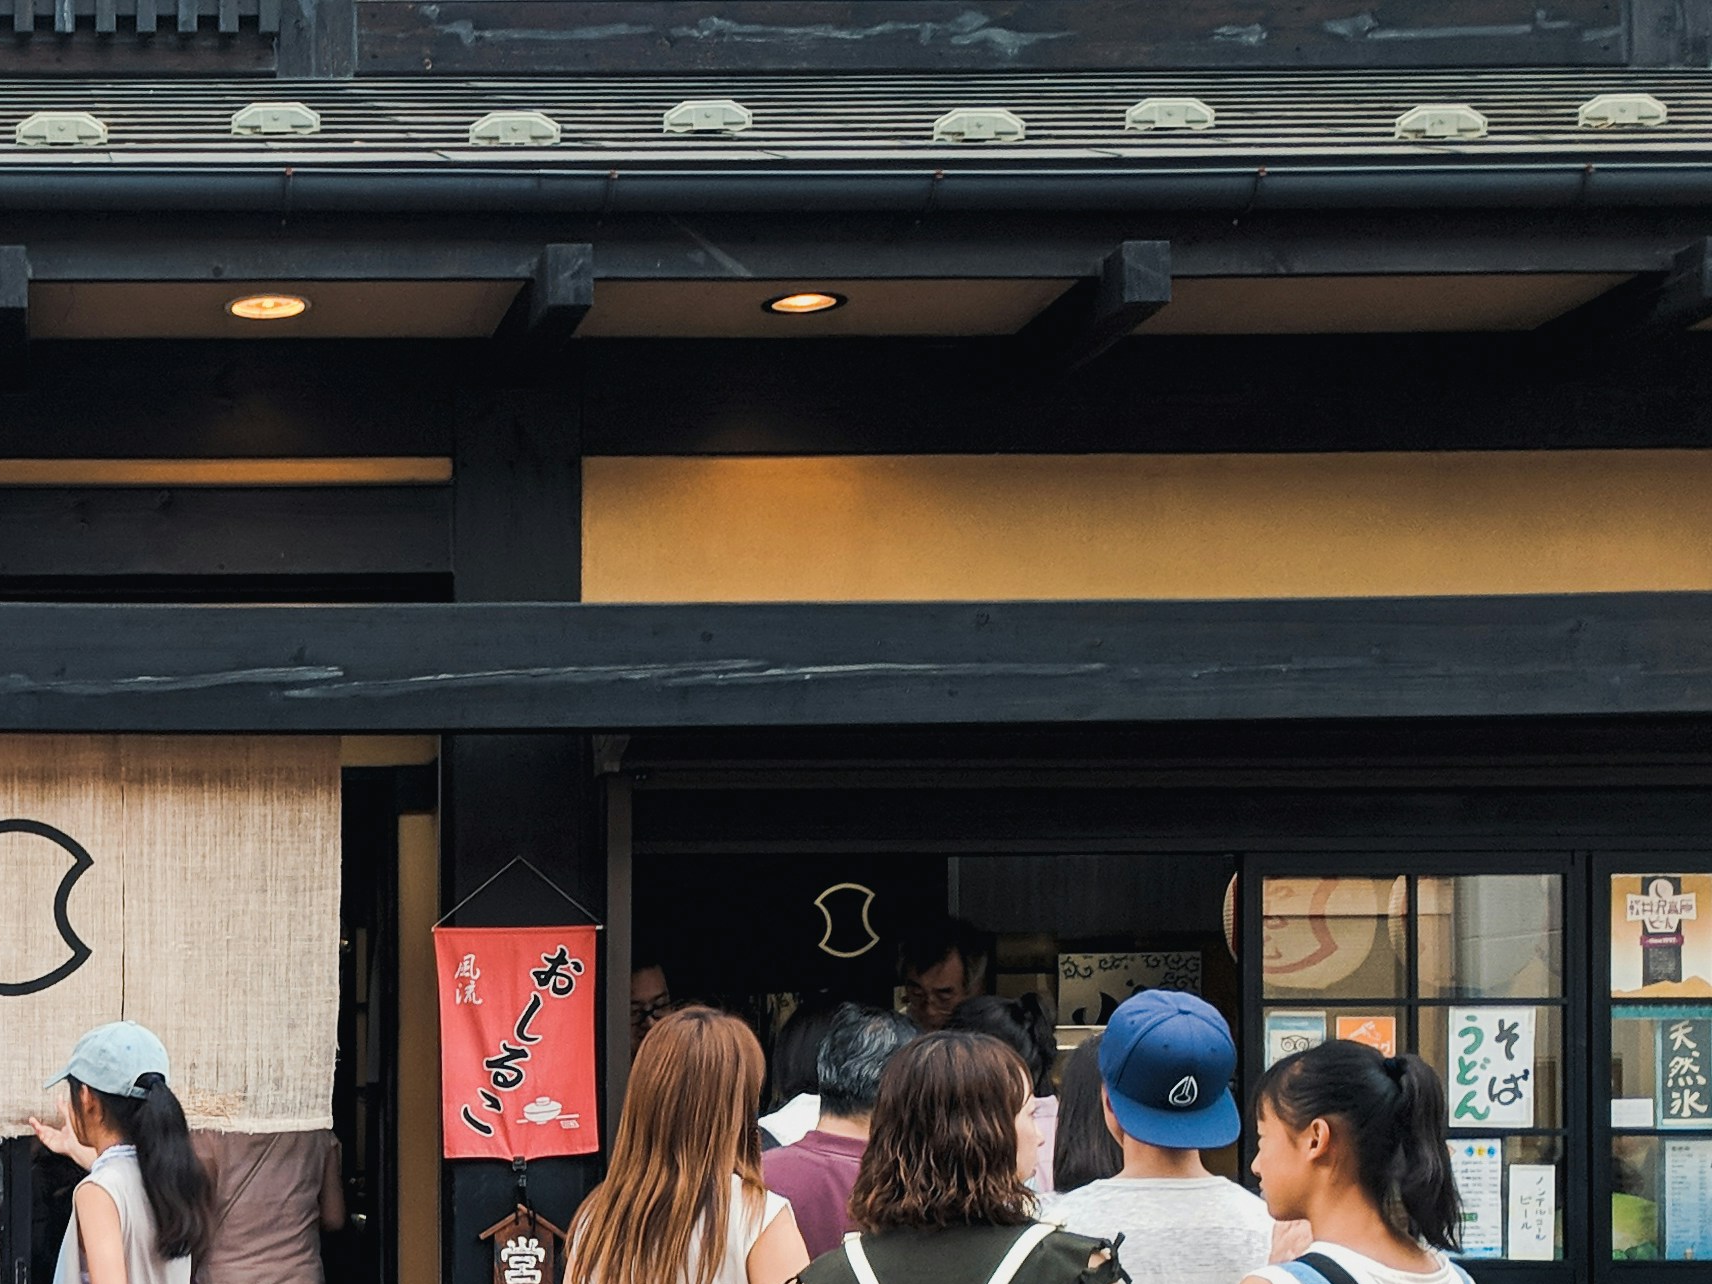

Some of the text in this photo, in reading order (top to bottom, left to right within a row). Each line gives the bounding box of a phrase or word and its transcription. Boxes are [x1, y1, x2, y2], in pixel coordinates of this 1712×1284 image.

[454, 953, 483, 1005] 風流
[460, 944, 584, 1136] おしるこ
[1454, 1014, 1491, 1121] うどん
[1488, 1018, 1530, 1106] そば
[1667, 1020, 1708, 1117] 天然氷
